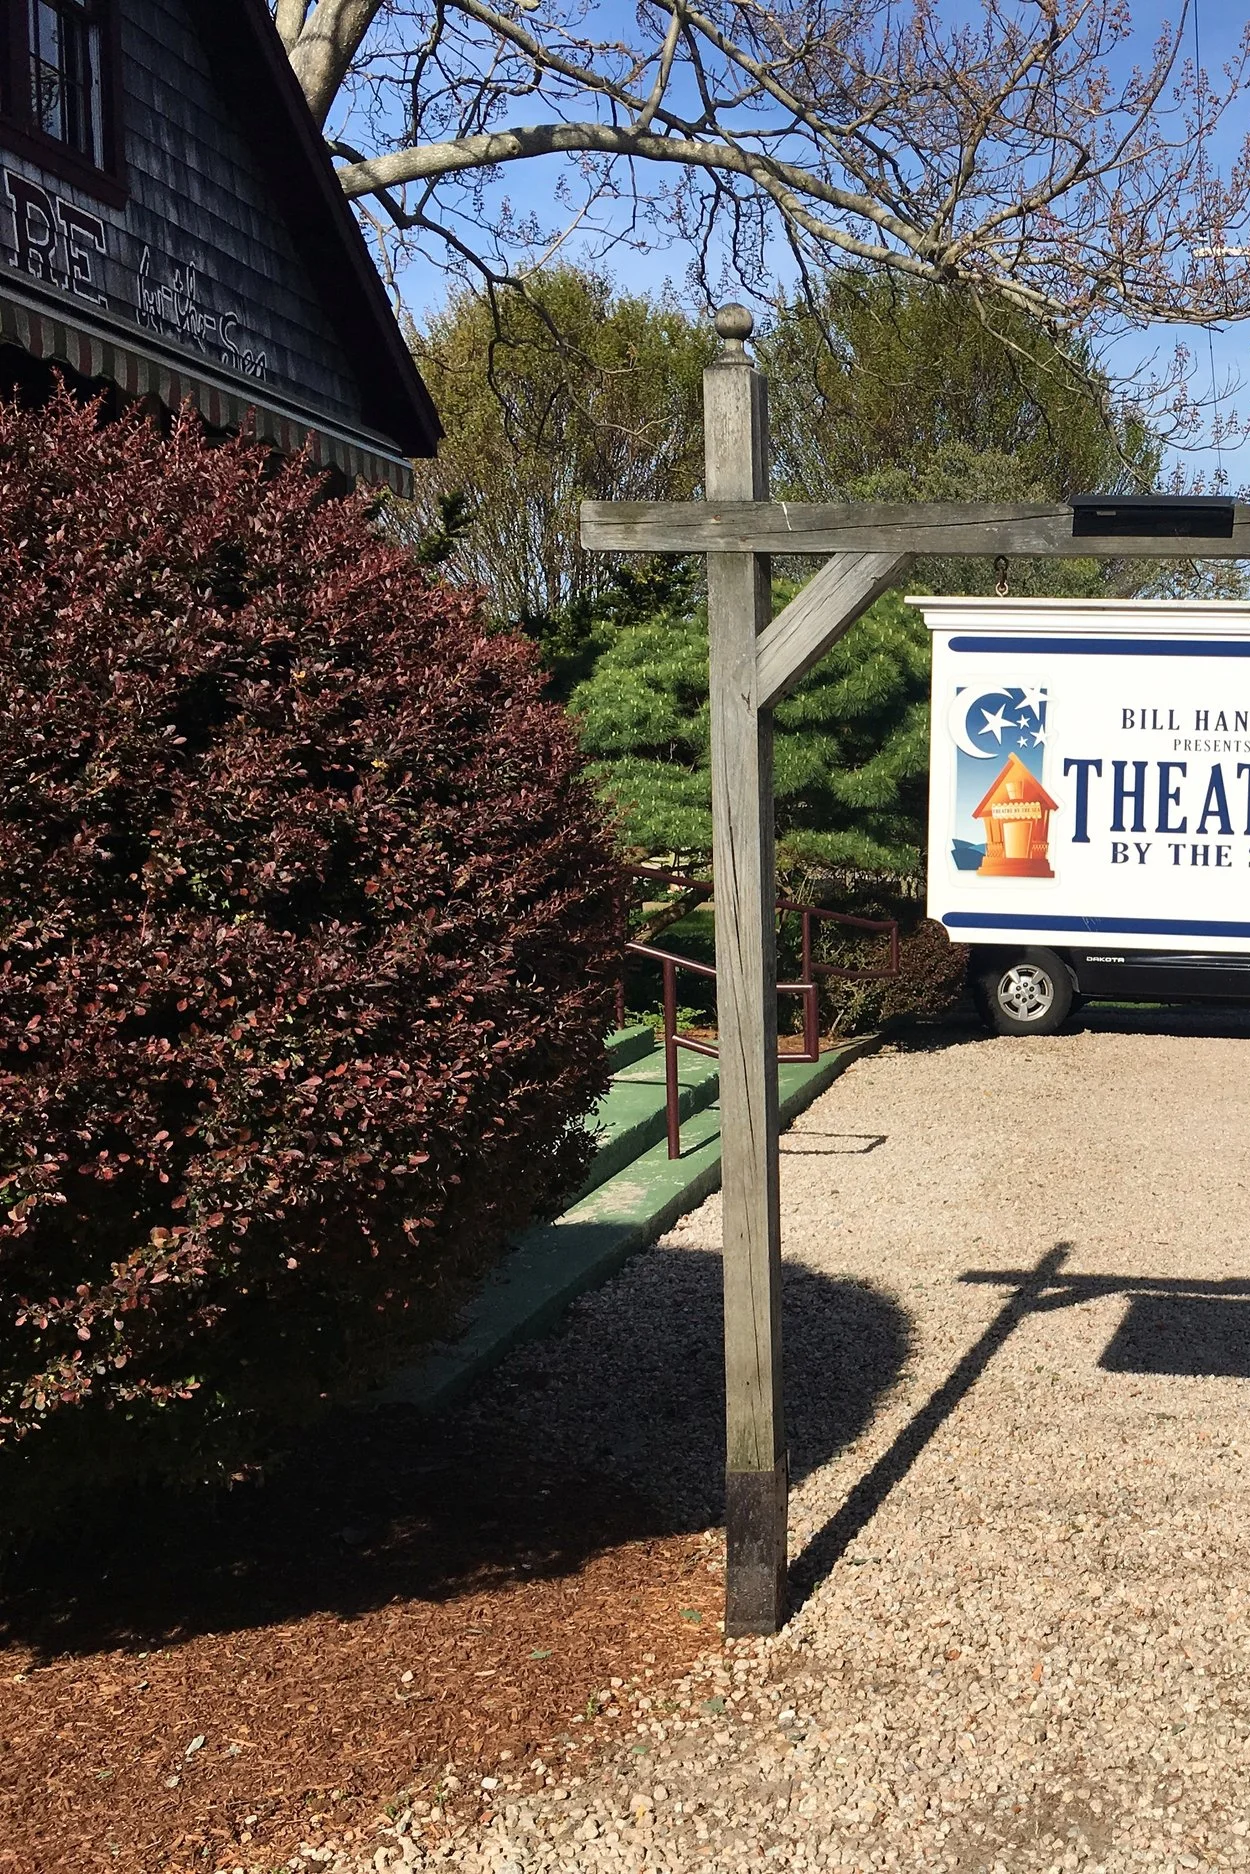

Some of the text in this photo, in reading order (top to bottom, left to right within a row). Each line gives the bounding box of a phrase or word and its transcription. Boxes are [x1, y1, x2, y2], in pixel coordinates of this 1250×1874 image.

[1122, 708, 1180, 730] BILL
[1173, 738, 1250, 753] PRESENTS
[1111, 842, 1152, 864] BY
[1168, 843, 1233, 867] THE
